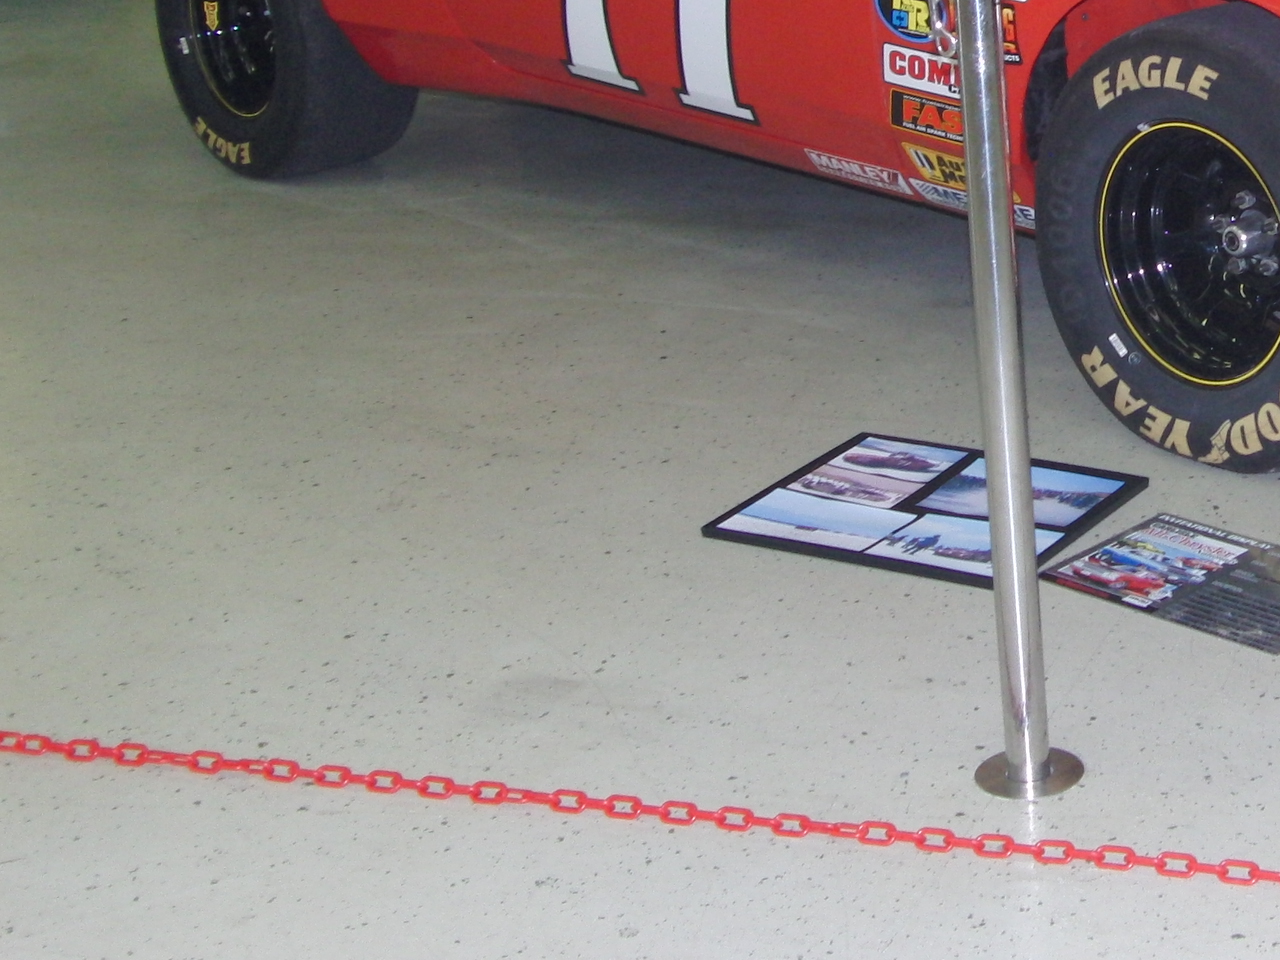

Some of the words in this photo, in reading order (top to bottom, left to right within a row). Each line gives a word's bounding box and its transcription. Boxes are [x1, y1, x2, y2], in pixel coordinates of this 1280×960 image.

[1092, 54, 1220, 110] EAGLE
[903, 98, 964, 135] FAS
[194, 115, 251, 165] EAGLE
[810, 152, 890, 183] MANLEY
